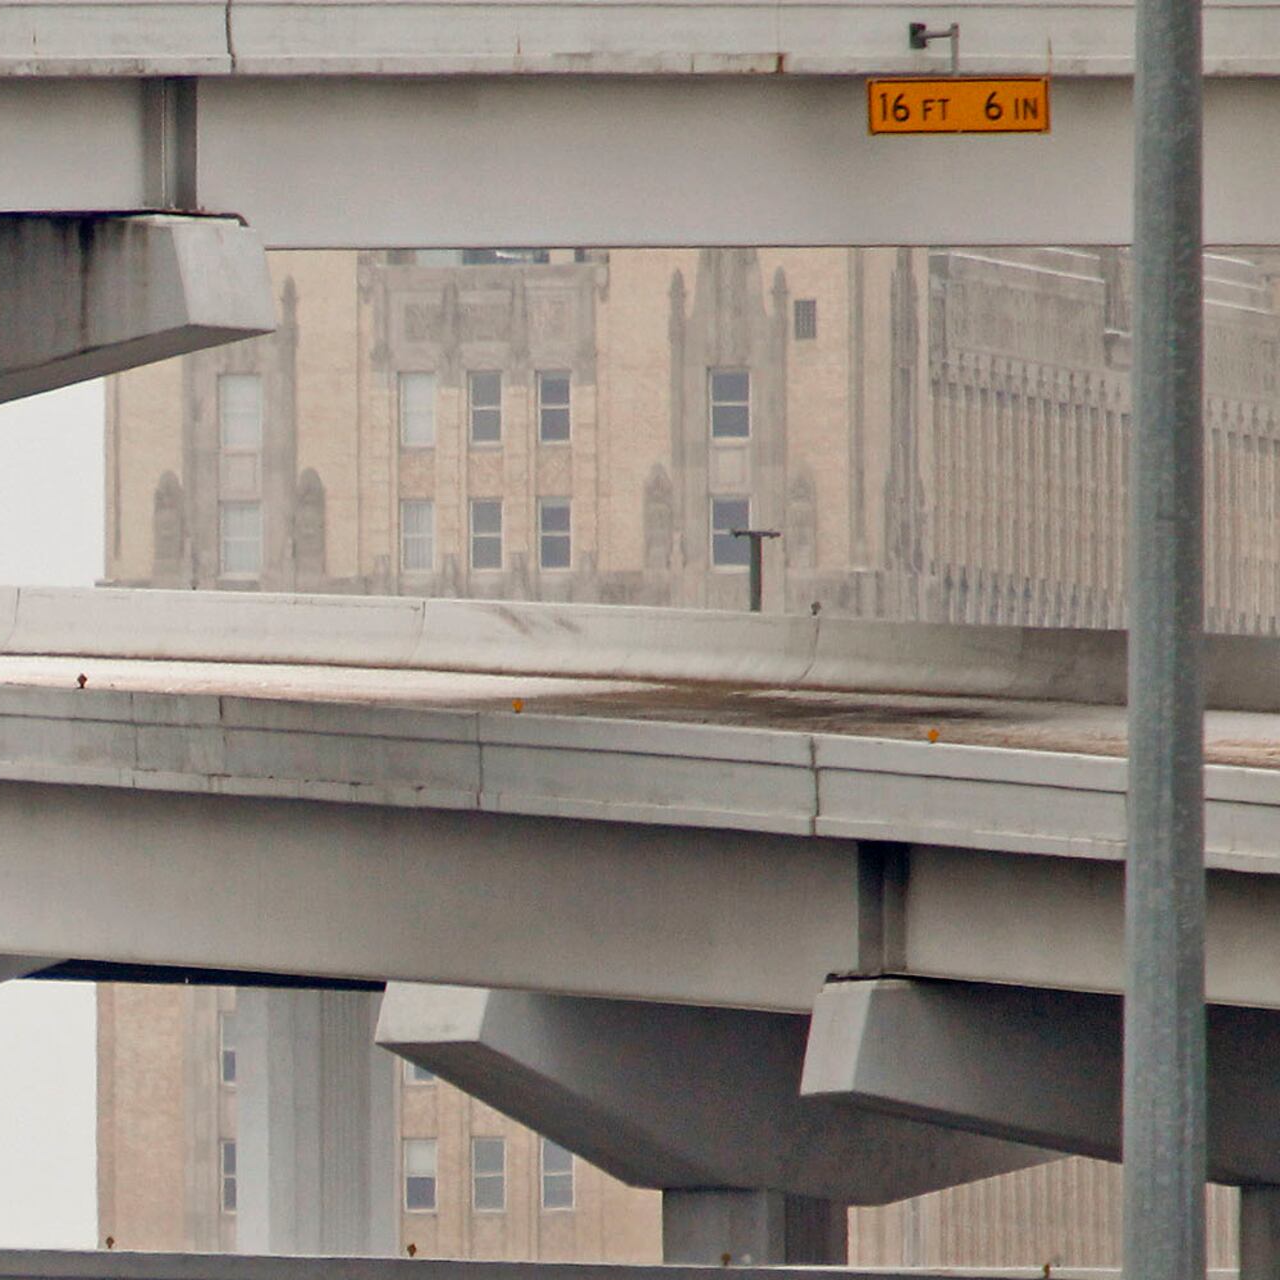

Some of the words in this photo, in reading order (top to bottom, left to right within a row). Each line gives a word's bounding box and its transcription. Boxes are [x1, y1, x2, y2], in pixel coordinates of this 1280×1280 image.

[880, 92, 910, 122] 16
[922, 98, 950, 121] FT
[985, 91, 1003, 121] 6
[1014, 98, 1038, 120] IN
